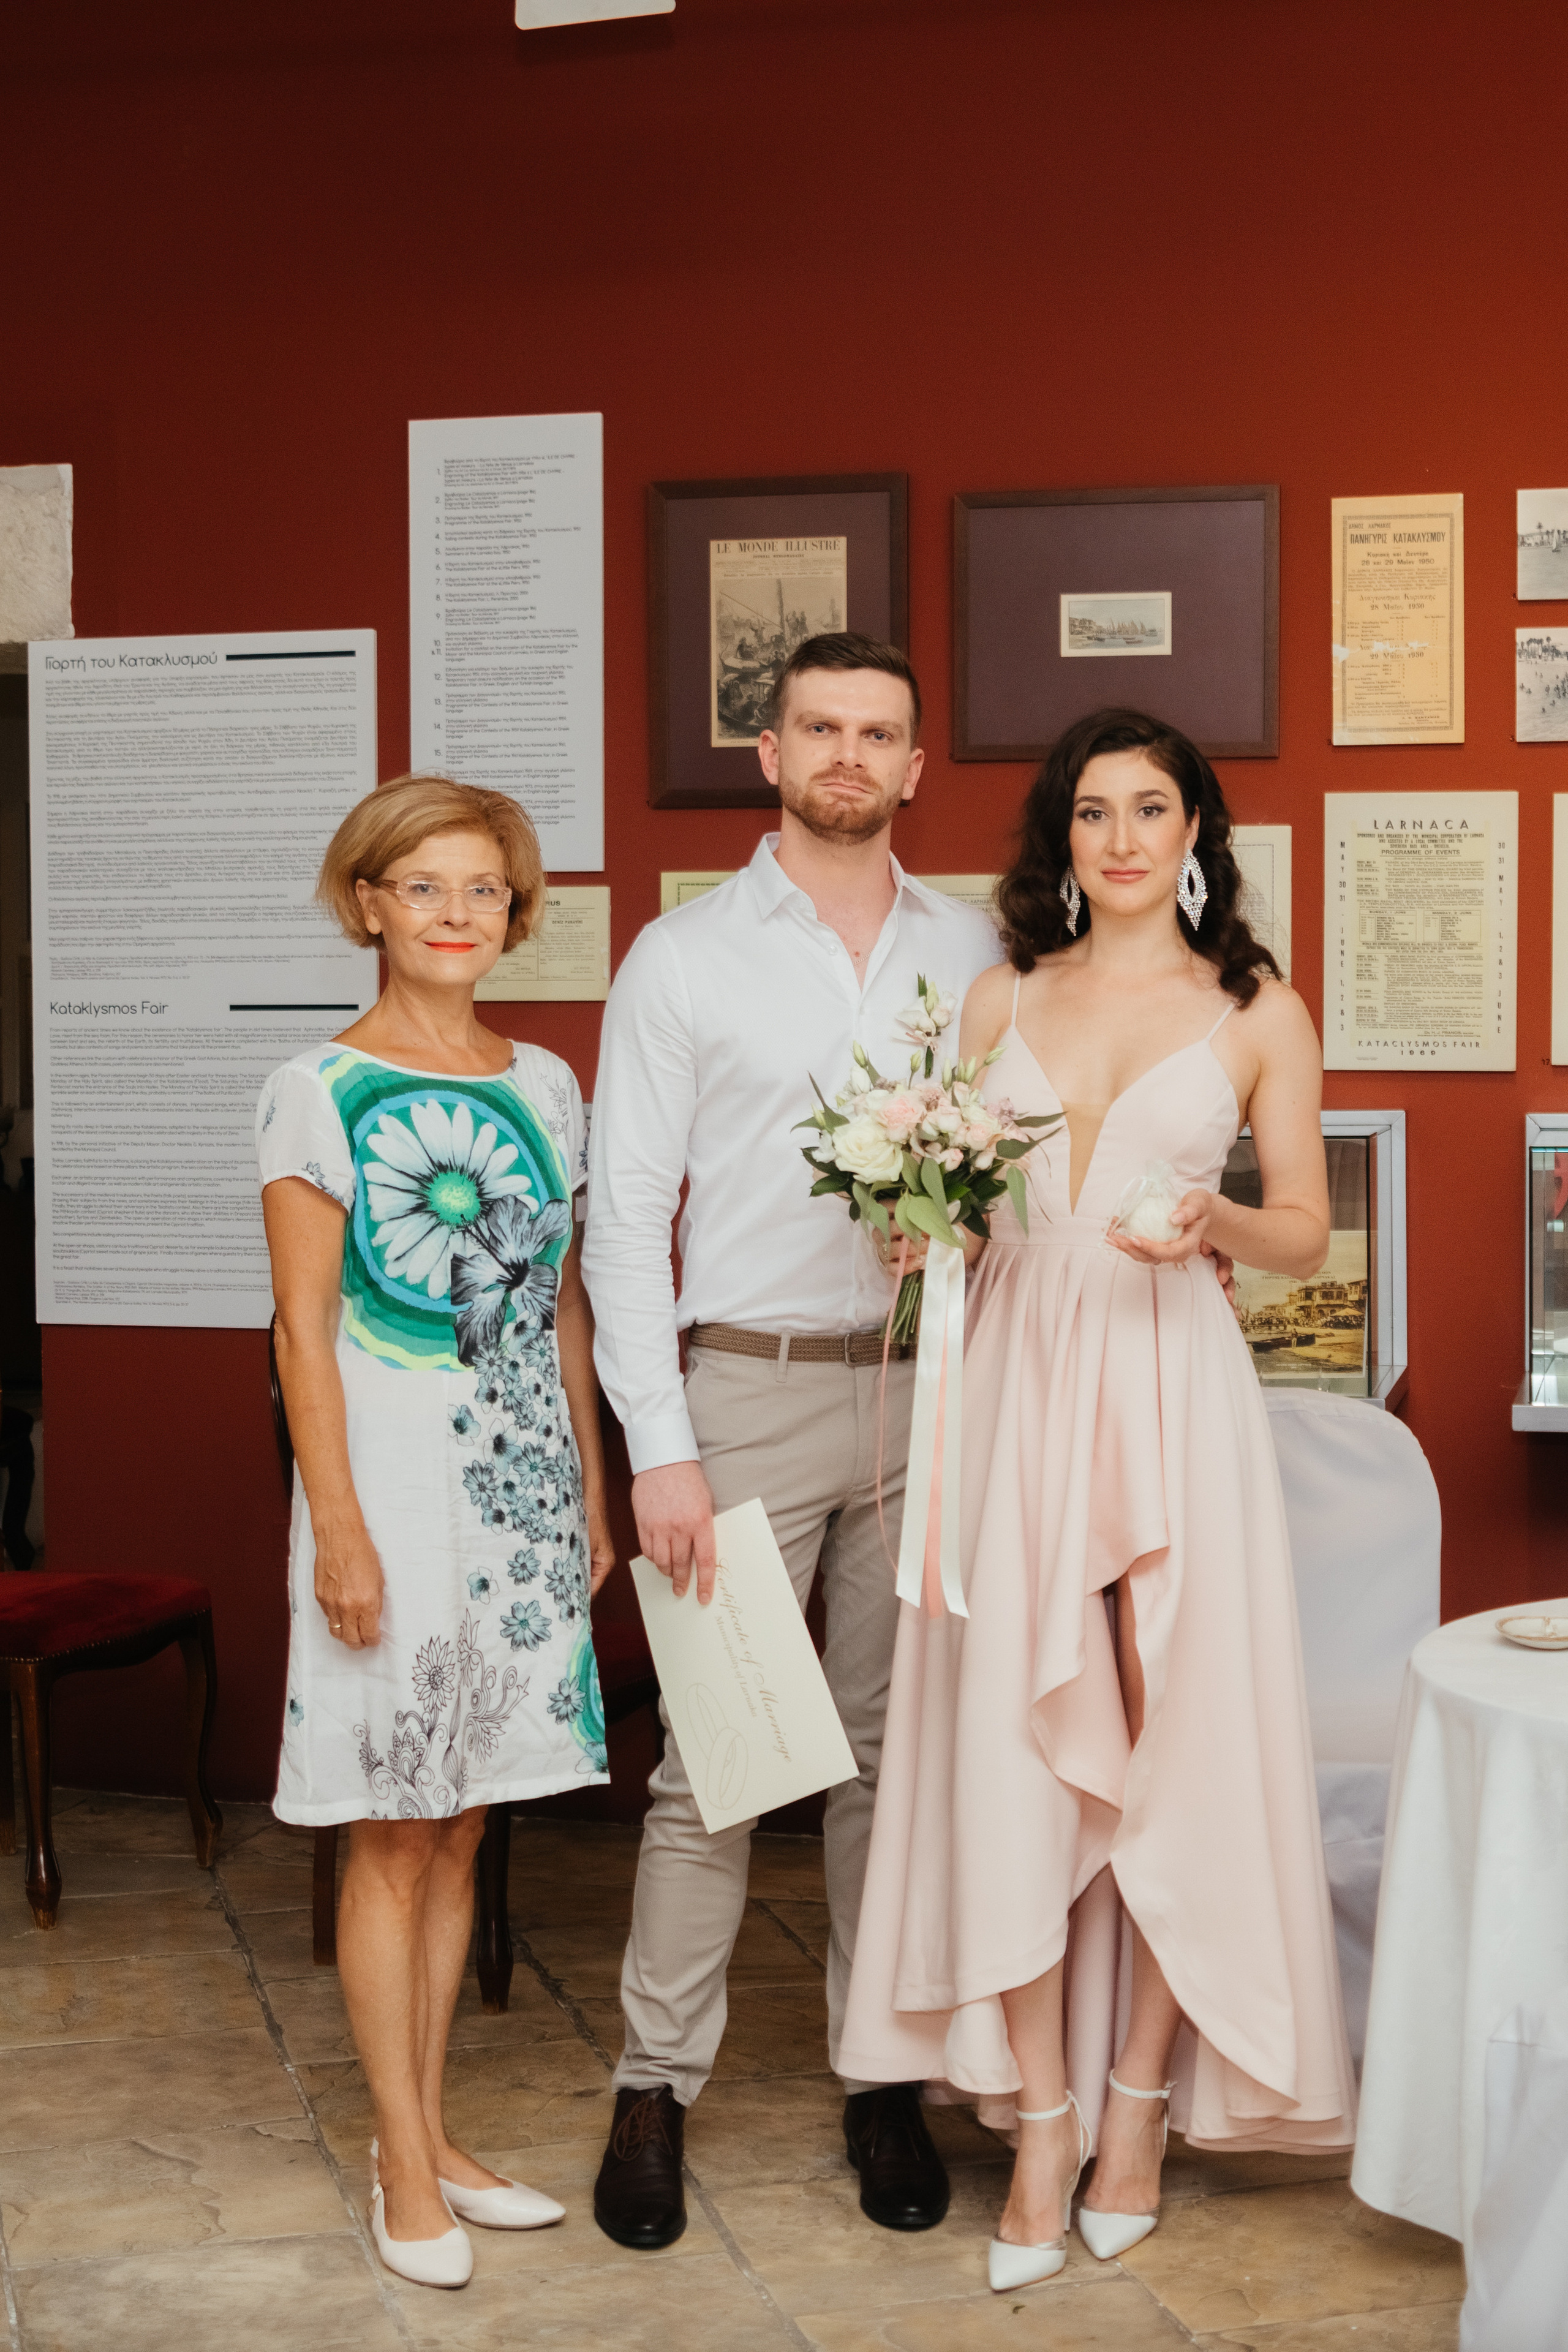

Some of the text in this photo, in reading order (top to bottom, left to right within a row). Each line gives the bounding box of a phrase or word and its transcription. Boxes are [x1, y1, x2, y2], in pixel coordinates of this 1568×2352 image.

[717, 538, 840, 554] LE MONDE ILLUSTRÉ
[1350, 532, 1446, 544] ΠΑΝΗΓΥΡΙΣ ΚΑΤΑΚΛΥΣΜΟΥ
[45, 652, 218, 673] Γιορτή του Κατακλυσμού
[1374, 820, 1469, 829] LARNACA
[50, 1001, 169, 1018] Kataklysmos Fair
[715, 1558, 791, 1762] Certificate of Marriage
[715, 1616, 739, 1669] Municipality
[740, 1682, 757, 1717] Larnaka
